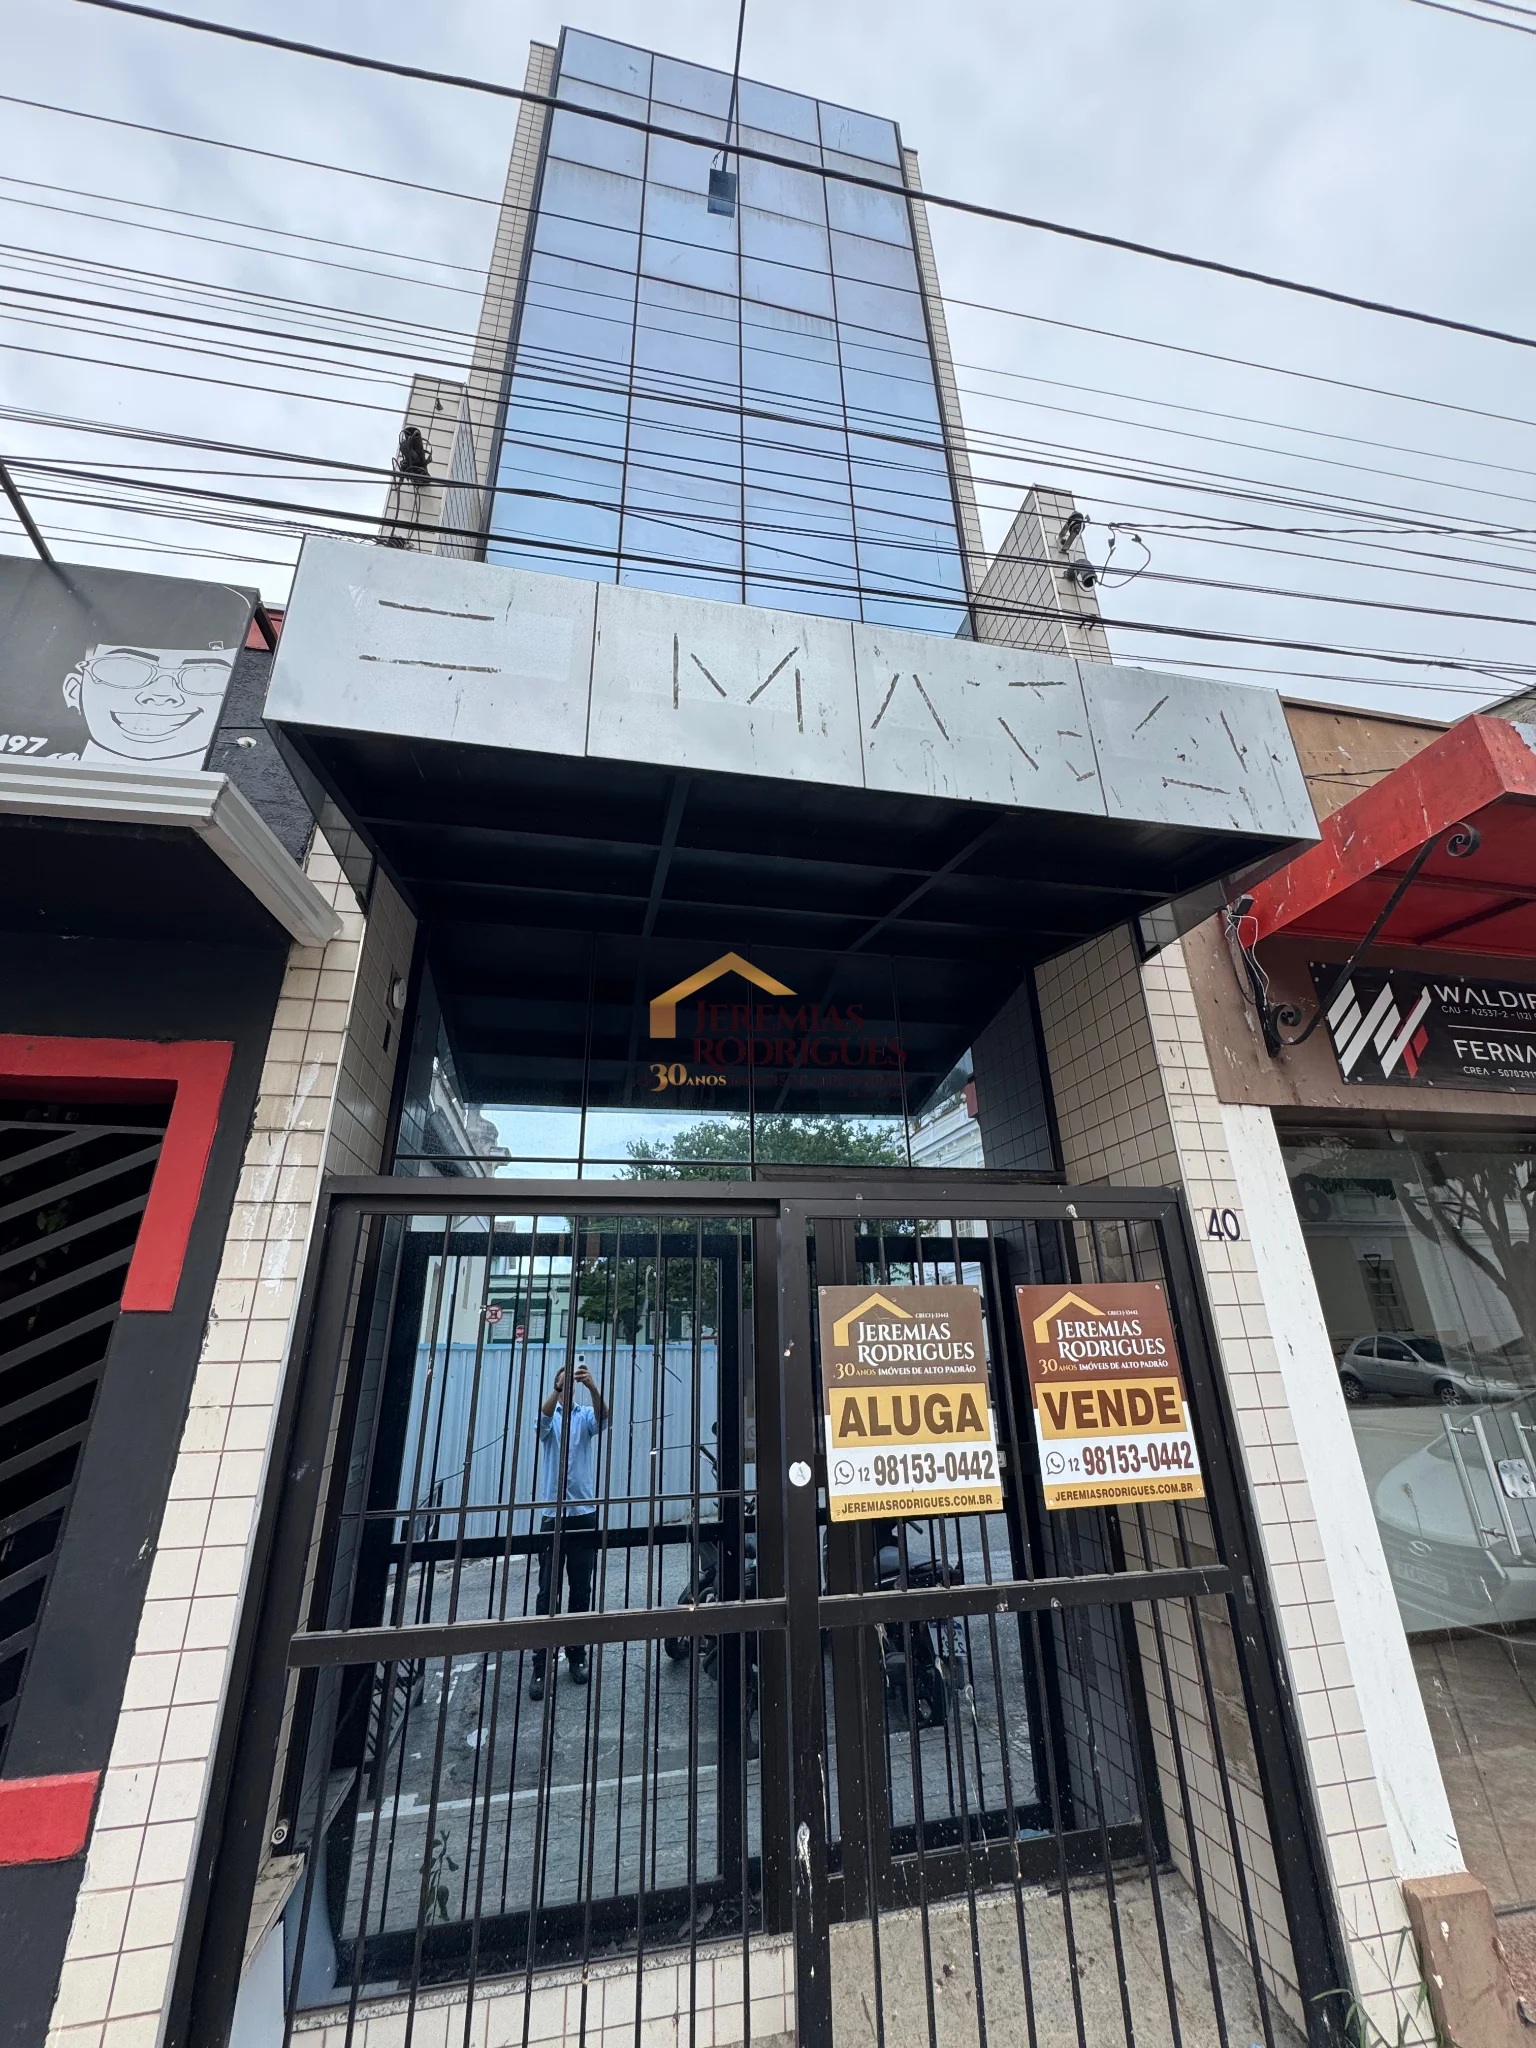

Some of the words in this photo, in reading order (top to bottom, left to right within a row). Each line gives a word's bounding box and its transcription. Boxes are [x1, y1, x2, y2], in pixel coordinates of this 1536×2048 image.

[1441, 1005, 1461, 1014] CAU
[1463, 1065, 1490, 1076] CREA
[1497, 1068, 1536, 1079] 5070291
[1208, 1208, 1240, 1241] 40
[857, 1321, 951, 1344] JEREMIAS
[1056, 1319, 1142, 1340] JEREMIAS
[857, 1342, 975, 1366] RODRIGUES
[1058, 1338, 1166, 1362] RODRIGUES
[835, 1363, 855, 1379] 30
[855, 1368, 876, 1376] ANOS
[878, 1366, 911, 1376] IMÓVEIS
[912, 1366, 923, 1375] DE
[924, 1366, 944, 1374] ALTO
[945, 1363, 976, 1374] PADRÃO
[1038, 1358, 1058, 1375] 30
[1058, 1364, 1078, 1372] ANOS
[1079, 1361, 1109, 1371] IMÓVEIS
[1110, 1361, 1120, 1370] DE
[1121, 1361, 1139, 1369] ALTO
[1140, 1358, 1168, 1368] PADRÃO
[838, 1393, 984, 1438] ALUGA
[1042, 1386, 1181, 1430] VENDE
[858, 1466, 871, 1482] 12
[873, 1450, 995, 1486] 98153-0442
[1068, 1457, 1081, 1472] 12
[1082, 1441, 1194, 1475] 98153-0442
[841, 1494, 993, 1514] JEREMIASRODRIGUES.COM.BR
[1055, 1483, 1193, 1502] JEREMIASRODRIGUES.COM.BR
